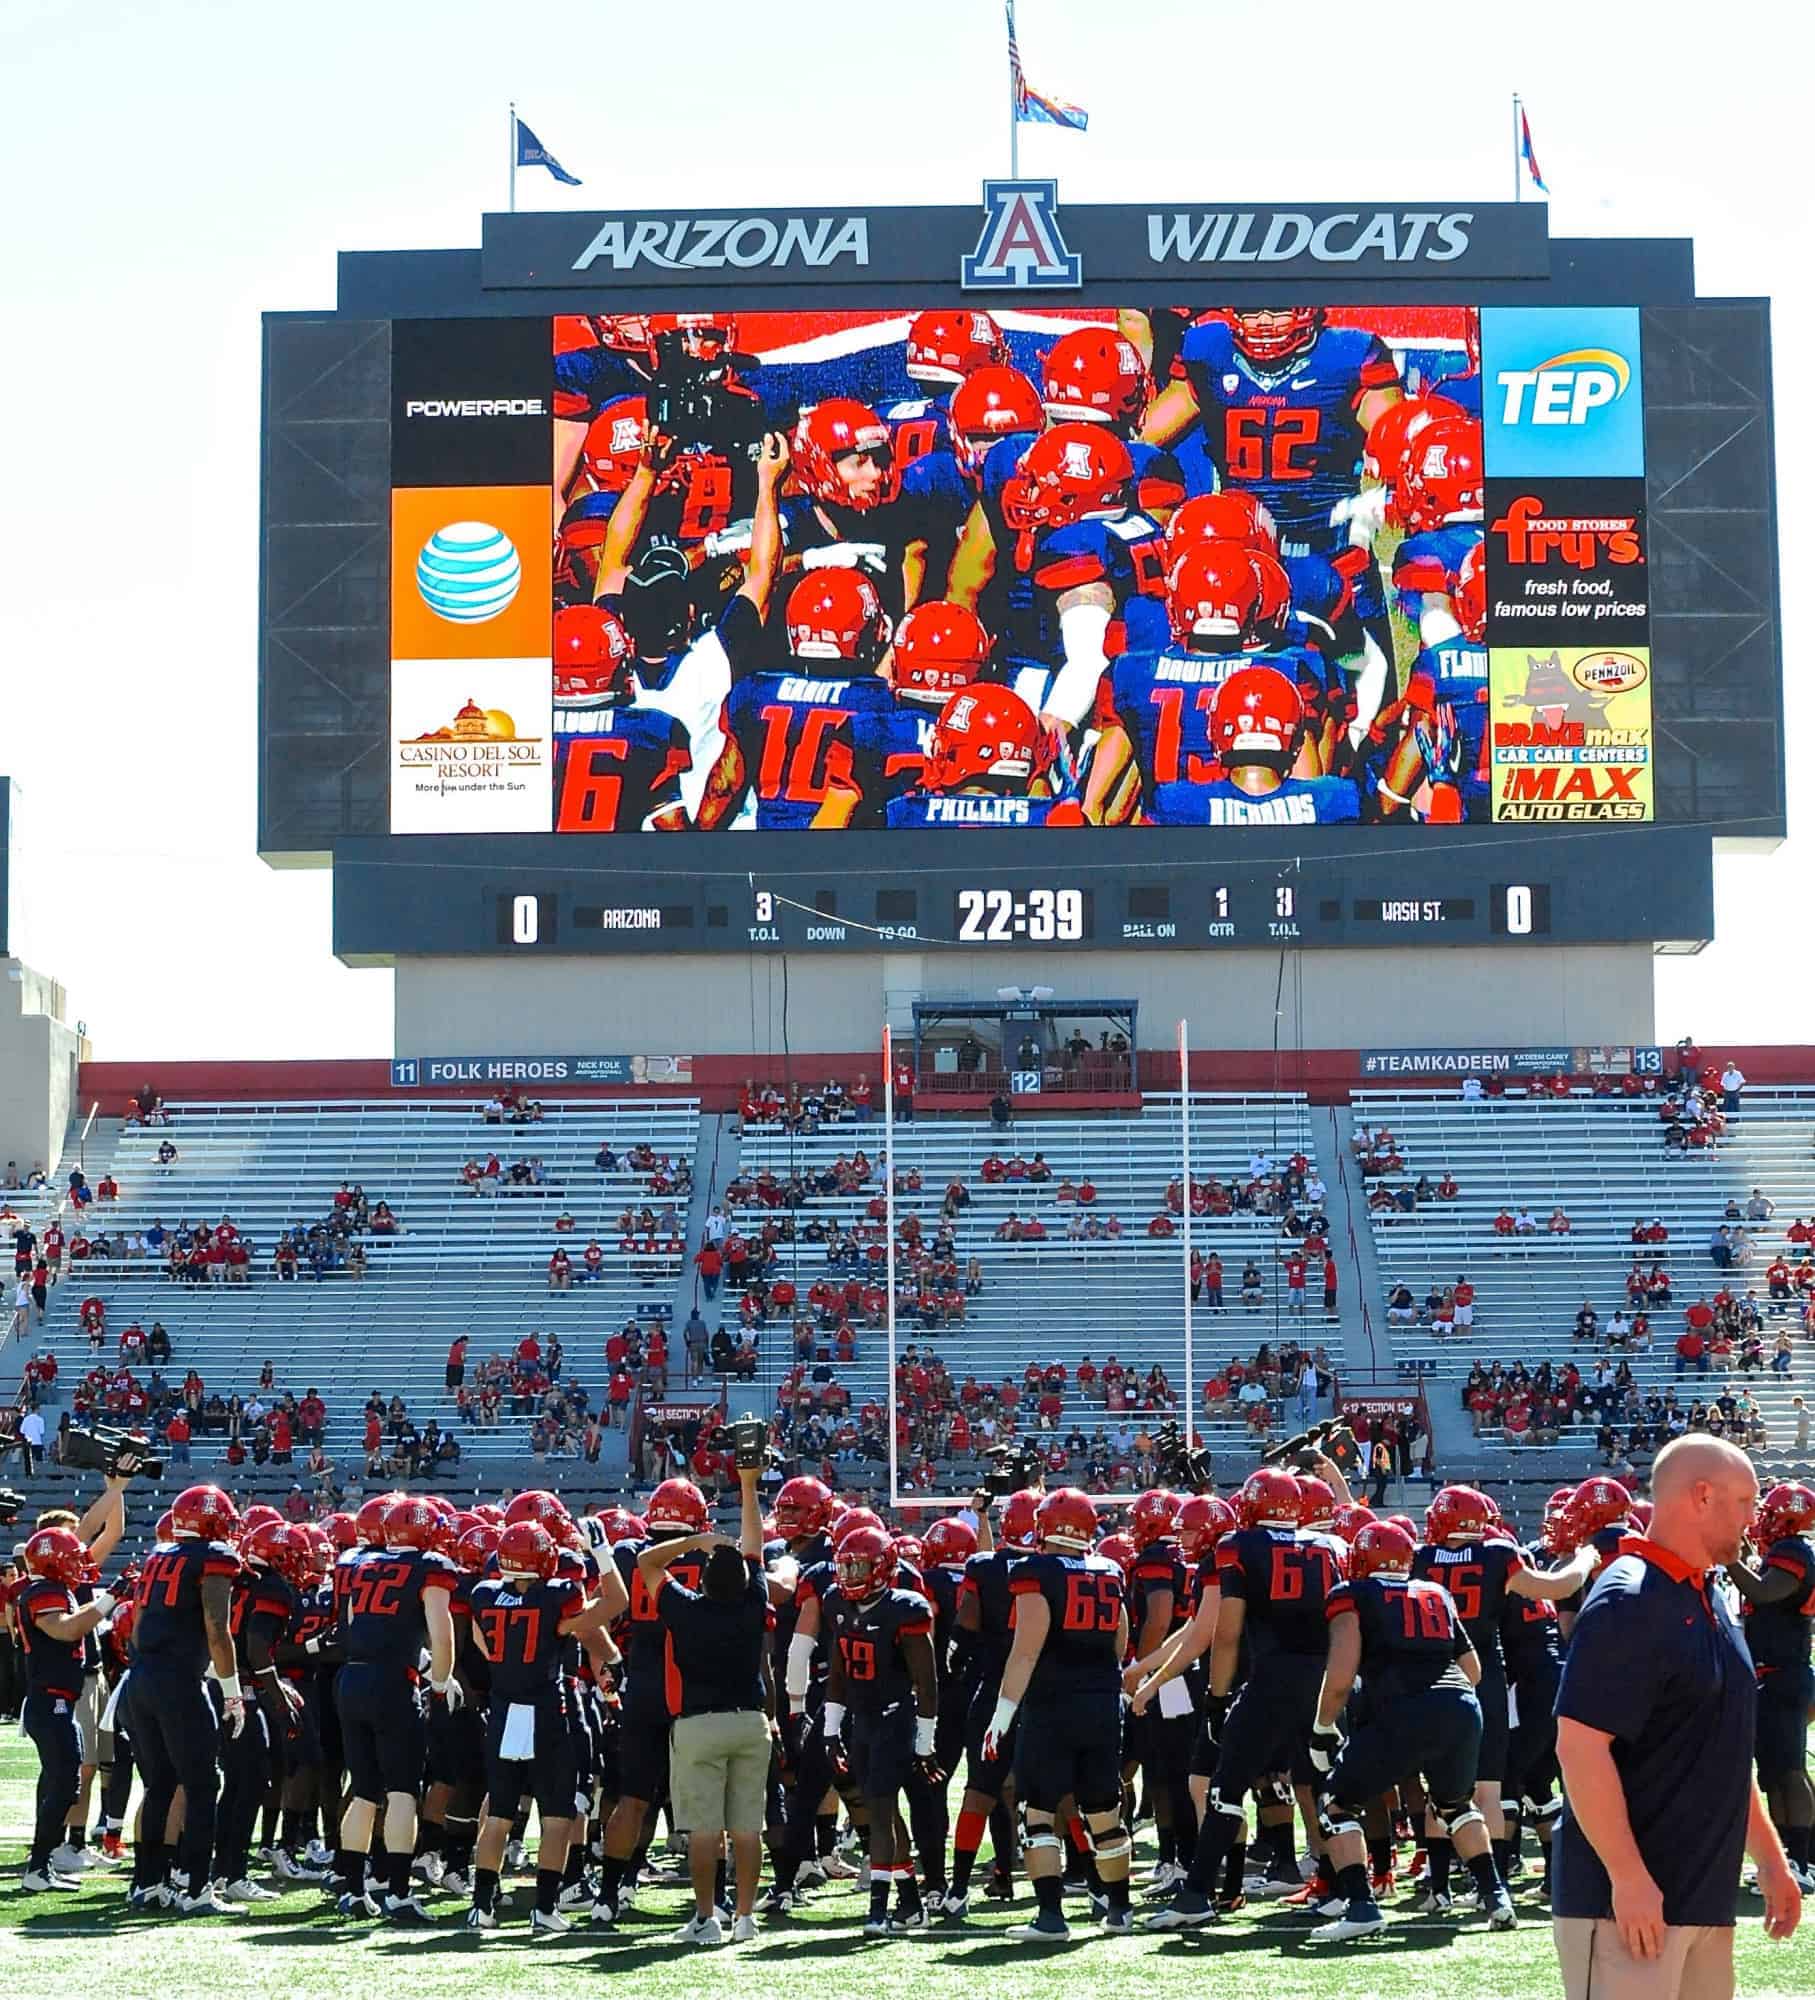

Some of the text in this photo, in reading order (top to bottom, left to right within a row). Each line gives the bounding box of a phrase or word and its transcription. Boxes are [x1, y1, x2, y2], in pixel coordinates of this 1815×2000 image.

[571, 217, 870, 271] ARIZONA
[961, 180, 1082, 289] A
[1147, 212, 1474, 263] WILDCATS
[1497, 371, 1617, 425] TEP
[1225, 409, 1320, 479] 62
[1527, 519, 1628, 532] FOOD STORES
[1525, 579, 1614, 597] fresh food,
[1495, 600, 1647, 620] famous low prices
[1438, 650, 1488, 679] FLAN
[1584, 667, 1637, 681] PENNZOIL
[1494, 722, 1584, 748] BRAKE
[400, 745, 541, 761] CASINO DEL SOL
[1498, 749, 1645, 763] CAR CARE CENTERS
[438, 763, 501, 778] RESORT
[415, 784, 439, 792] More
[459, 782, 486, 791] under
[489, 782, 505, 790] the
[507, 781, 525, 790] Sun
[554, 738, 628, 832] 6
[1511, 768, 1645, 800] MAX
[925, 798, 1029, 821] PHILLIPS
[1501, 803, 1643, 820] AUTO GLASS
[756, 892, 773, 921] 3
[1215, 887, 1228, 917] 1
[1276, 887, 1294, 917] 3
[1382, 901, 1446, 921] WASH ST.
[1506, 886, 1532, 934] 0
[513, 896, 538, 943] 0
[603, 909, 661, 928] ARIZONA
[959, 889, 1083, 941] 22:39
[807, 927, 846, 941] DOWN
[879, 926, 917, 941] TO GO
[1123, 923, 1176, 938] BALL ON
[1209, 923, 1235, 936] QTR
[431, 1063, 482, 1080] FOLK
[487, 1062, 568, 1080] HEROES
[577, 1061, 621, 1069] NICK FOLK
[1365, 1055, 1510, 1072] #TEAMKADEEM
[1637, 1052, 1660, 1071] 13
[395, 1063, 416, 1083] 11
[1014, 1075, 1038, 1092] 12
[1270, 1546, 1333, 1600] 67
[1063, 1574, 1120, 1630] 65
[481, 1608, 540, 1663] 37
